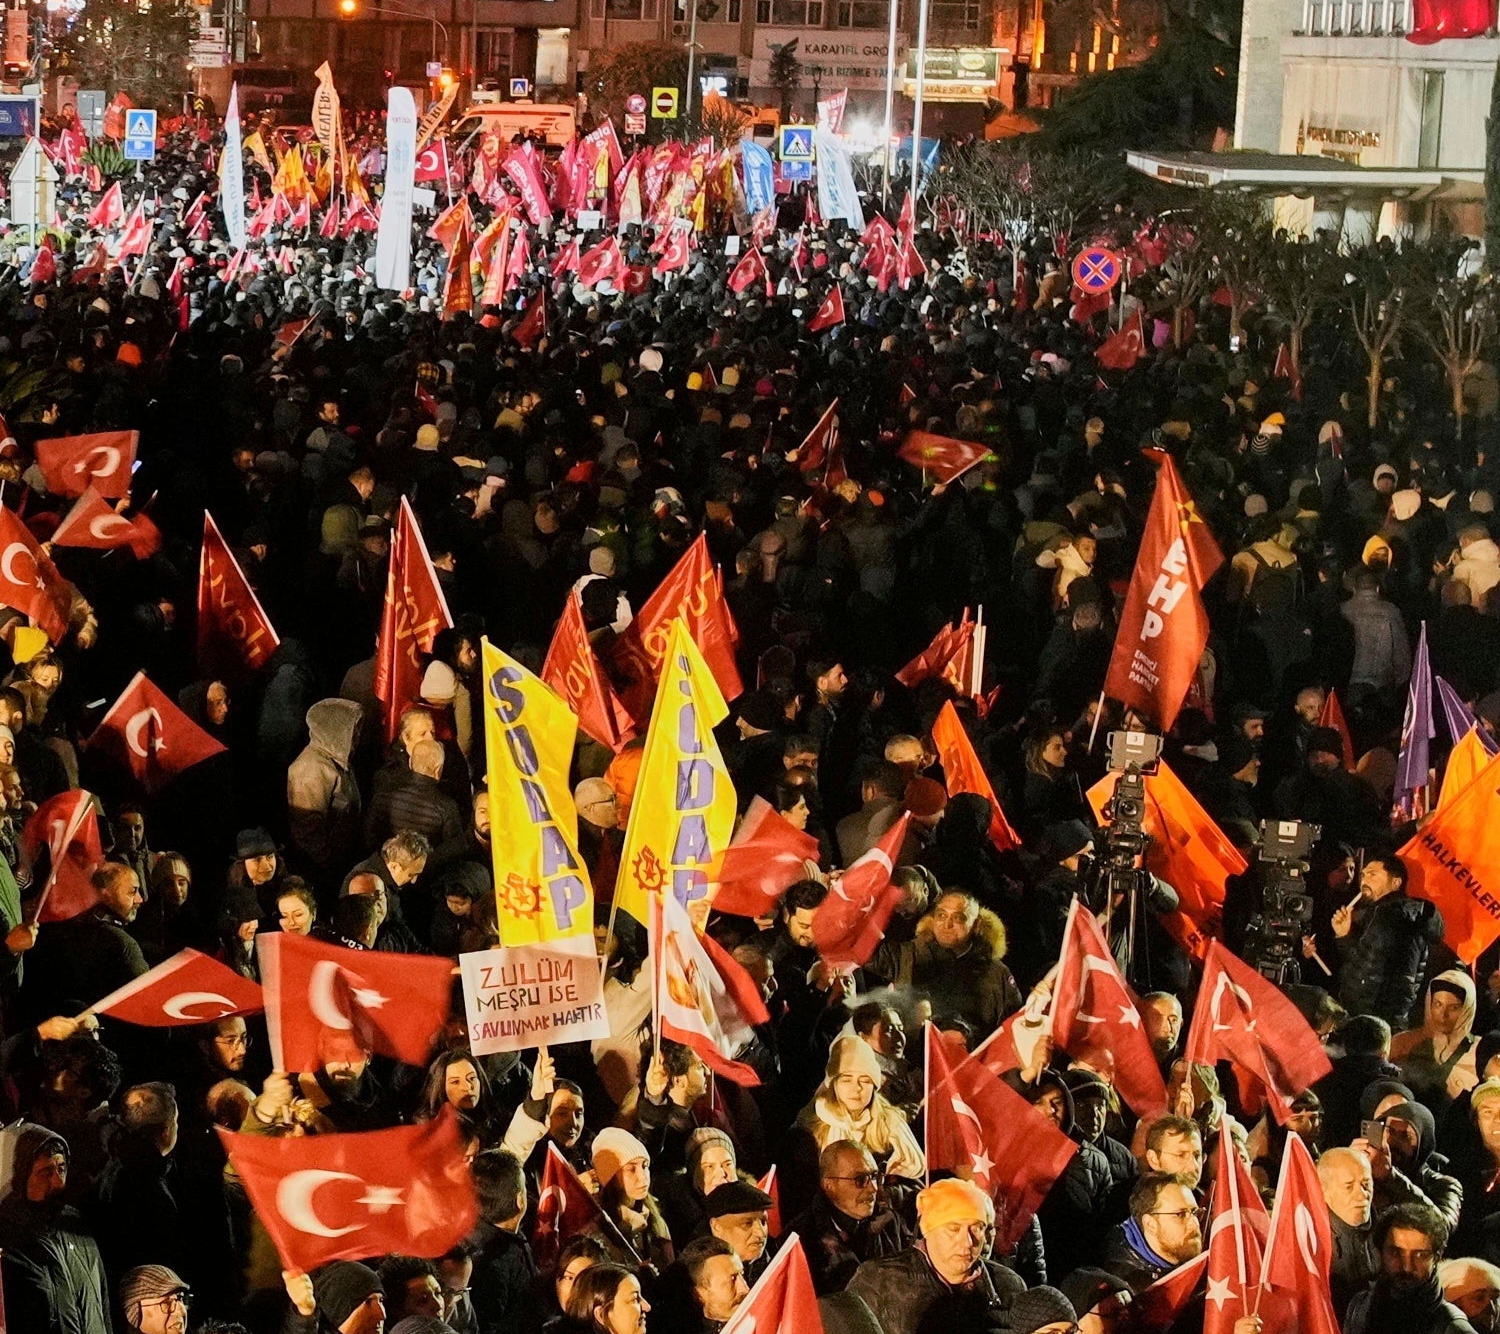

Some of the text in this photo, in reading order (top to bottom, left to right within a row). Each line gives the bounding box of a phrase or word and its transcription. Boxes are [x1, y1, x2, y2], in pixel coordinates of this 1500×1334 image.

[863, 45, 904, 57] GROP
[1140, 536, 1188, 642] EHP
[480, 956, 574, 990] ZULÜM
[477, 986, 540, 1013] MEŞRU
[472, 1001, 603, 1043] SAVUNMAK HAKTIR
